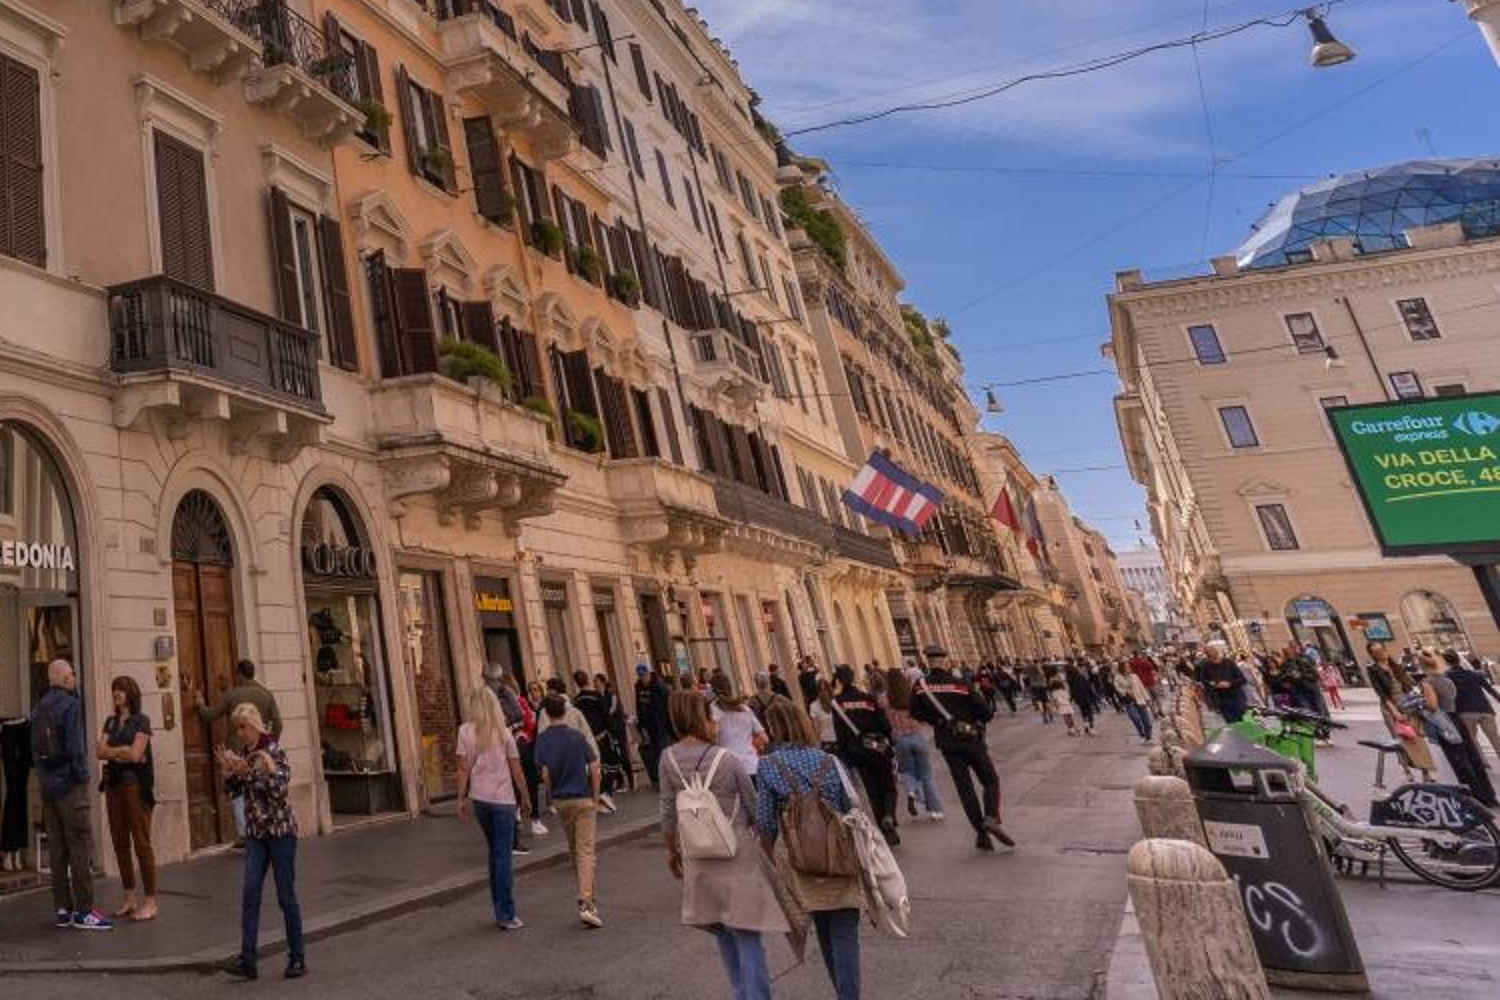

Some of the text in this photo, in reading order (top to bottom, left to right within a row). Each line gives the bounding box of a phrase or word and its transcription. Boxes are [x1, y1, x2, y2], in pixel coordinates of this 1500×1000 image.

[1351, 415, 1444, 435] Carrefour
[1394, 429, 1449, 443] express
[1374, 445, 1497, 469] VIA DELLA
[1384, 469, 1477, 489] CROCE,
